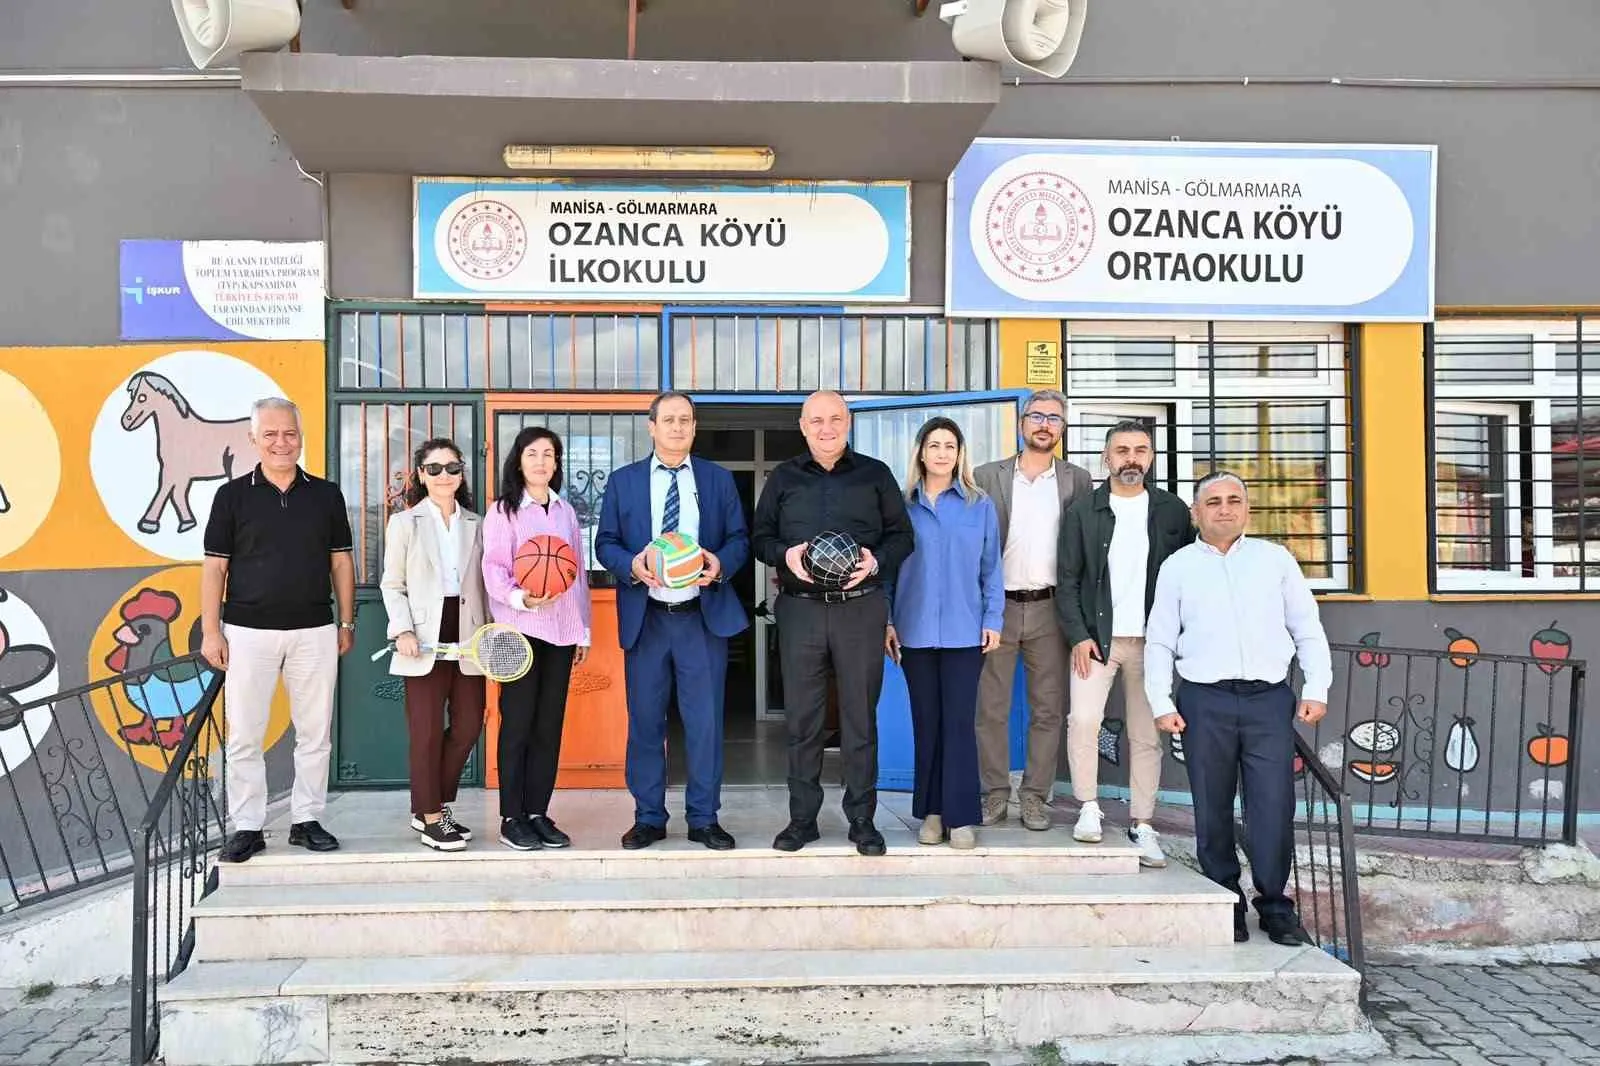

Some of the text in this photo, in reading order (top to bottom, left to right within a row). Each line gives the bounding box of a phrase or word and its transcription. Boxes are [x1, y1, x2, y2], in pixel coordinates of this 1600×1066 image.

[1108, 177, 1171, 196] MANİSA
[1184, 179, 1302, 198] GÖLMARMARA
[550, 199, 606, 214] MANİSA
[616, 200, 718, 216] GÖLMARMARA
[549, 217, 786, 247] OZANCA KÖYÜ
[1108, 204, 1342, 240] OZANCA KÖYÜ
[276, 268, 320, 278] PROGRAM
[550, 253, 706, 284] İLKOKULU
[1107, 250, 1304, 283] ORTAOKULU
[225, 314, 291, 326] EDİLMEKTEDİR
